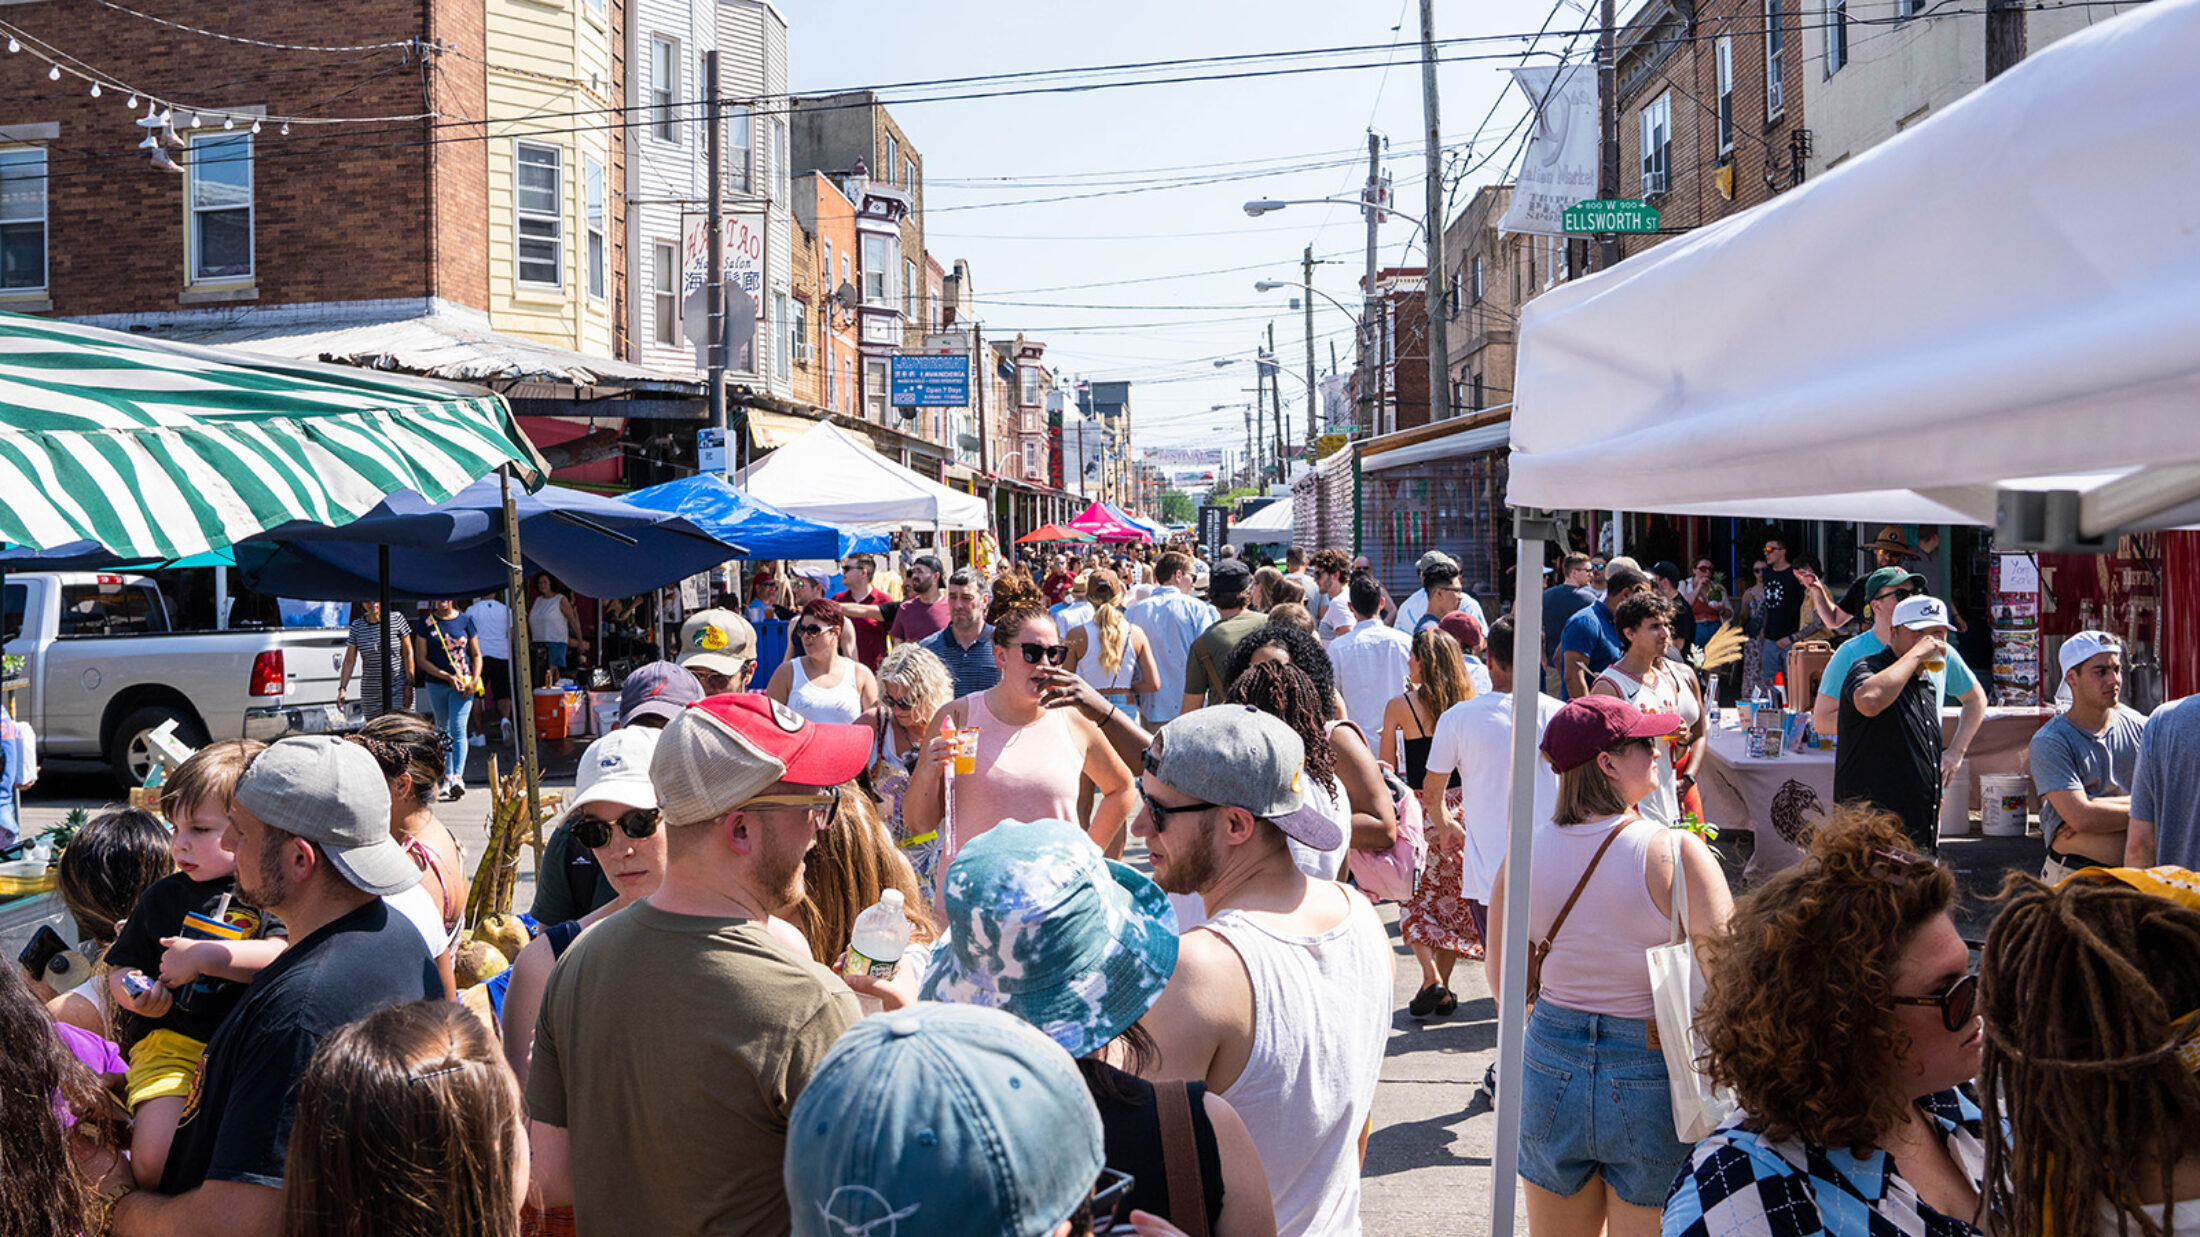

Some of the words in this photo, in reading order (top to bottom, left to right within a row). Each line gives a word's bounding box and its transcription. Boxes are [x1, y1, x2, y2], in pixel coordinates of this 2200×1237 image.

[1585, 202, 1602, 210] 800
[1605, 200, 1617, 210] W
[1619, 201, 1637, 209] 900
[1524, 211, 1562, 222] SPOR
[1565, 212, 1642, 231] ELLSWORTH
[1645, 216, 1657, 230] ST
[726, 218, 761, 260] TAO
[723, 255, 752, 270] Salon
[1049, 425, 1063, 489] PIZZA
[1159, 450, 1204, 464] FESTIVAL
